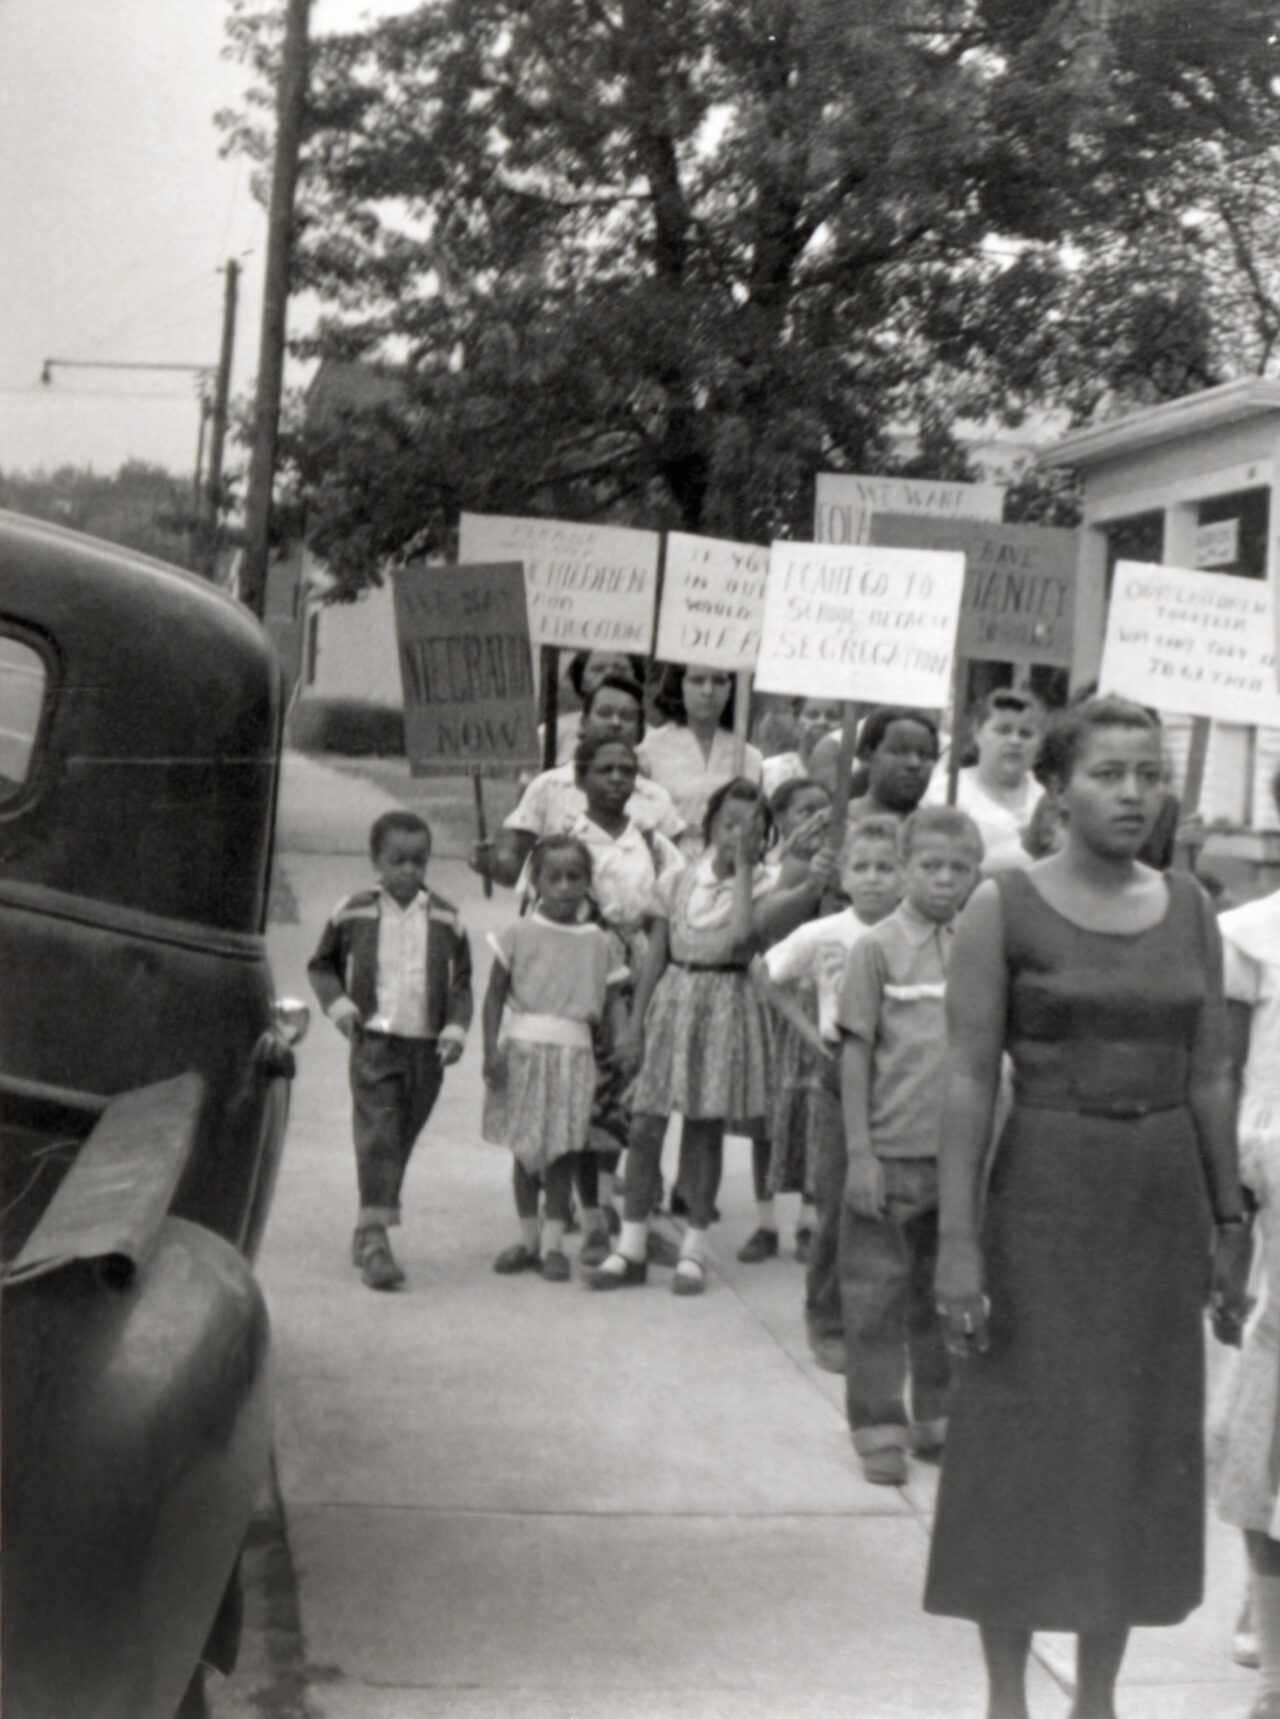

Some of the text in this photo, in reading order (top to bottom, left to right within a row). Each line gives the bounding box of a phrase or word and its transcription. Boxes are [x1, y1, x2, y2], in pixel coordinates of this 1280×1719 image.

[859, 567, 889, 598] GO
[905, 571, 934, 601] TO
[685, 597, 751, 620] WOULD
[773, 629, 949, 676] SEGREGATION
[436, 715, 523, 755] NOW
